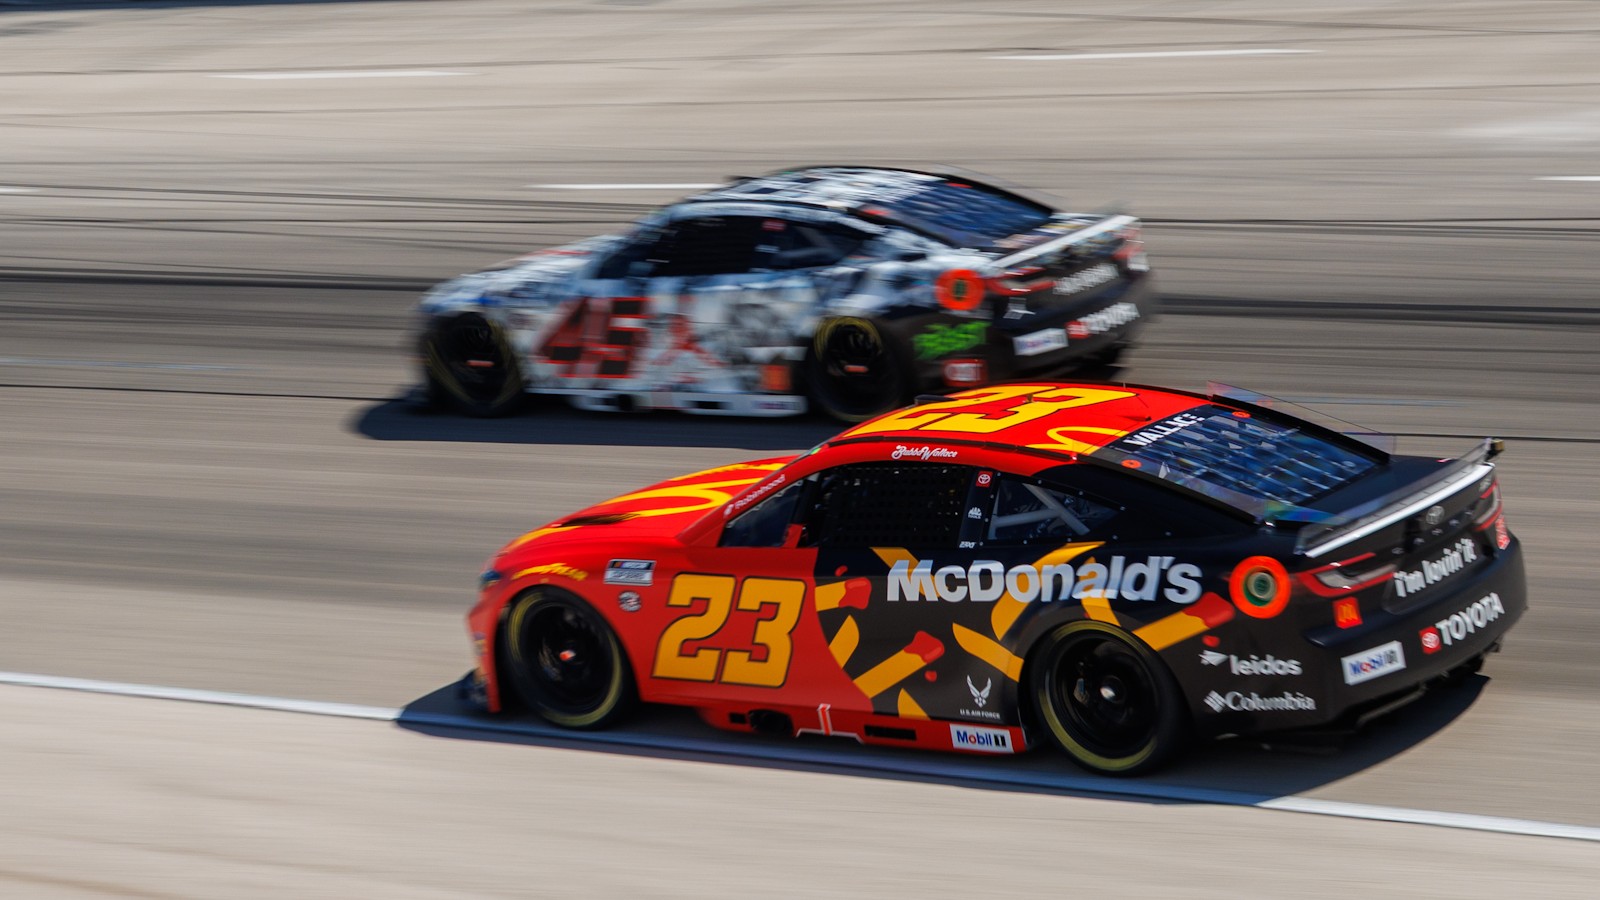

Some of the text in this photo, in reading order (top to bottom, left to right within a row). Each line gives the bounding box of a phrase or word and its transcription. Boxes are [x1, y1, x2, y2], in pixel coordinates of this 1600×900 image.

[842, 386, 1138, 437] 23
[920, 446, 958, 460] Wallace
[887, 555, 1203, 603] McDonald's
[651, 571, 807, 688] 23
[1435, 592, 1505, 646] TOYOTA
[1229, 654, 1303, 676] leidos
[1350, 654, 1385, 676] Mobil
[1225, 691, 1316, 711] Columbia
[981, 710, 1000, 718] FORCE
[956, 730, 992, 746] Mobil
